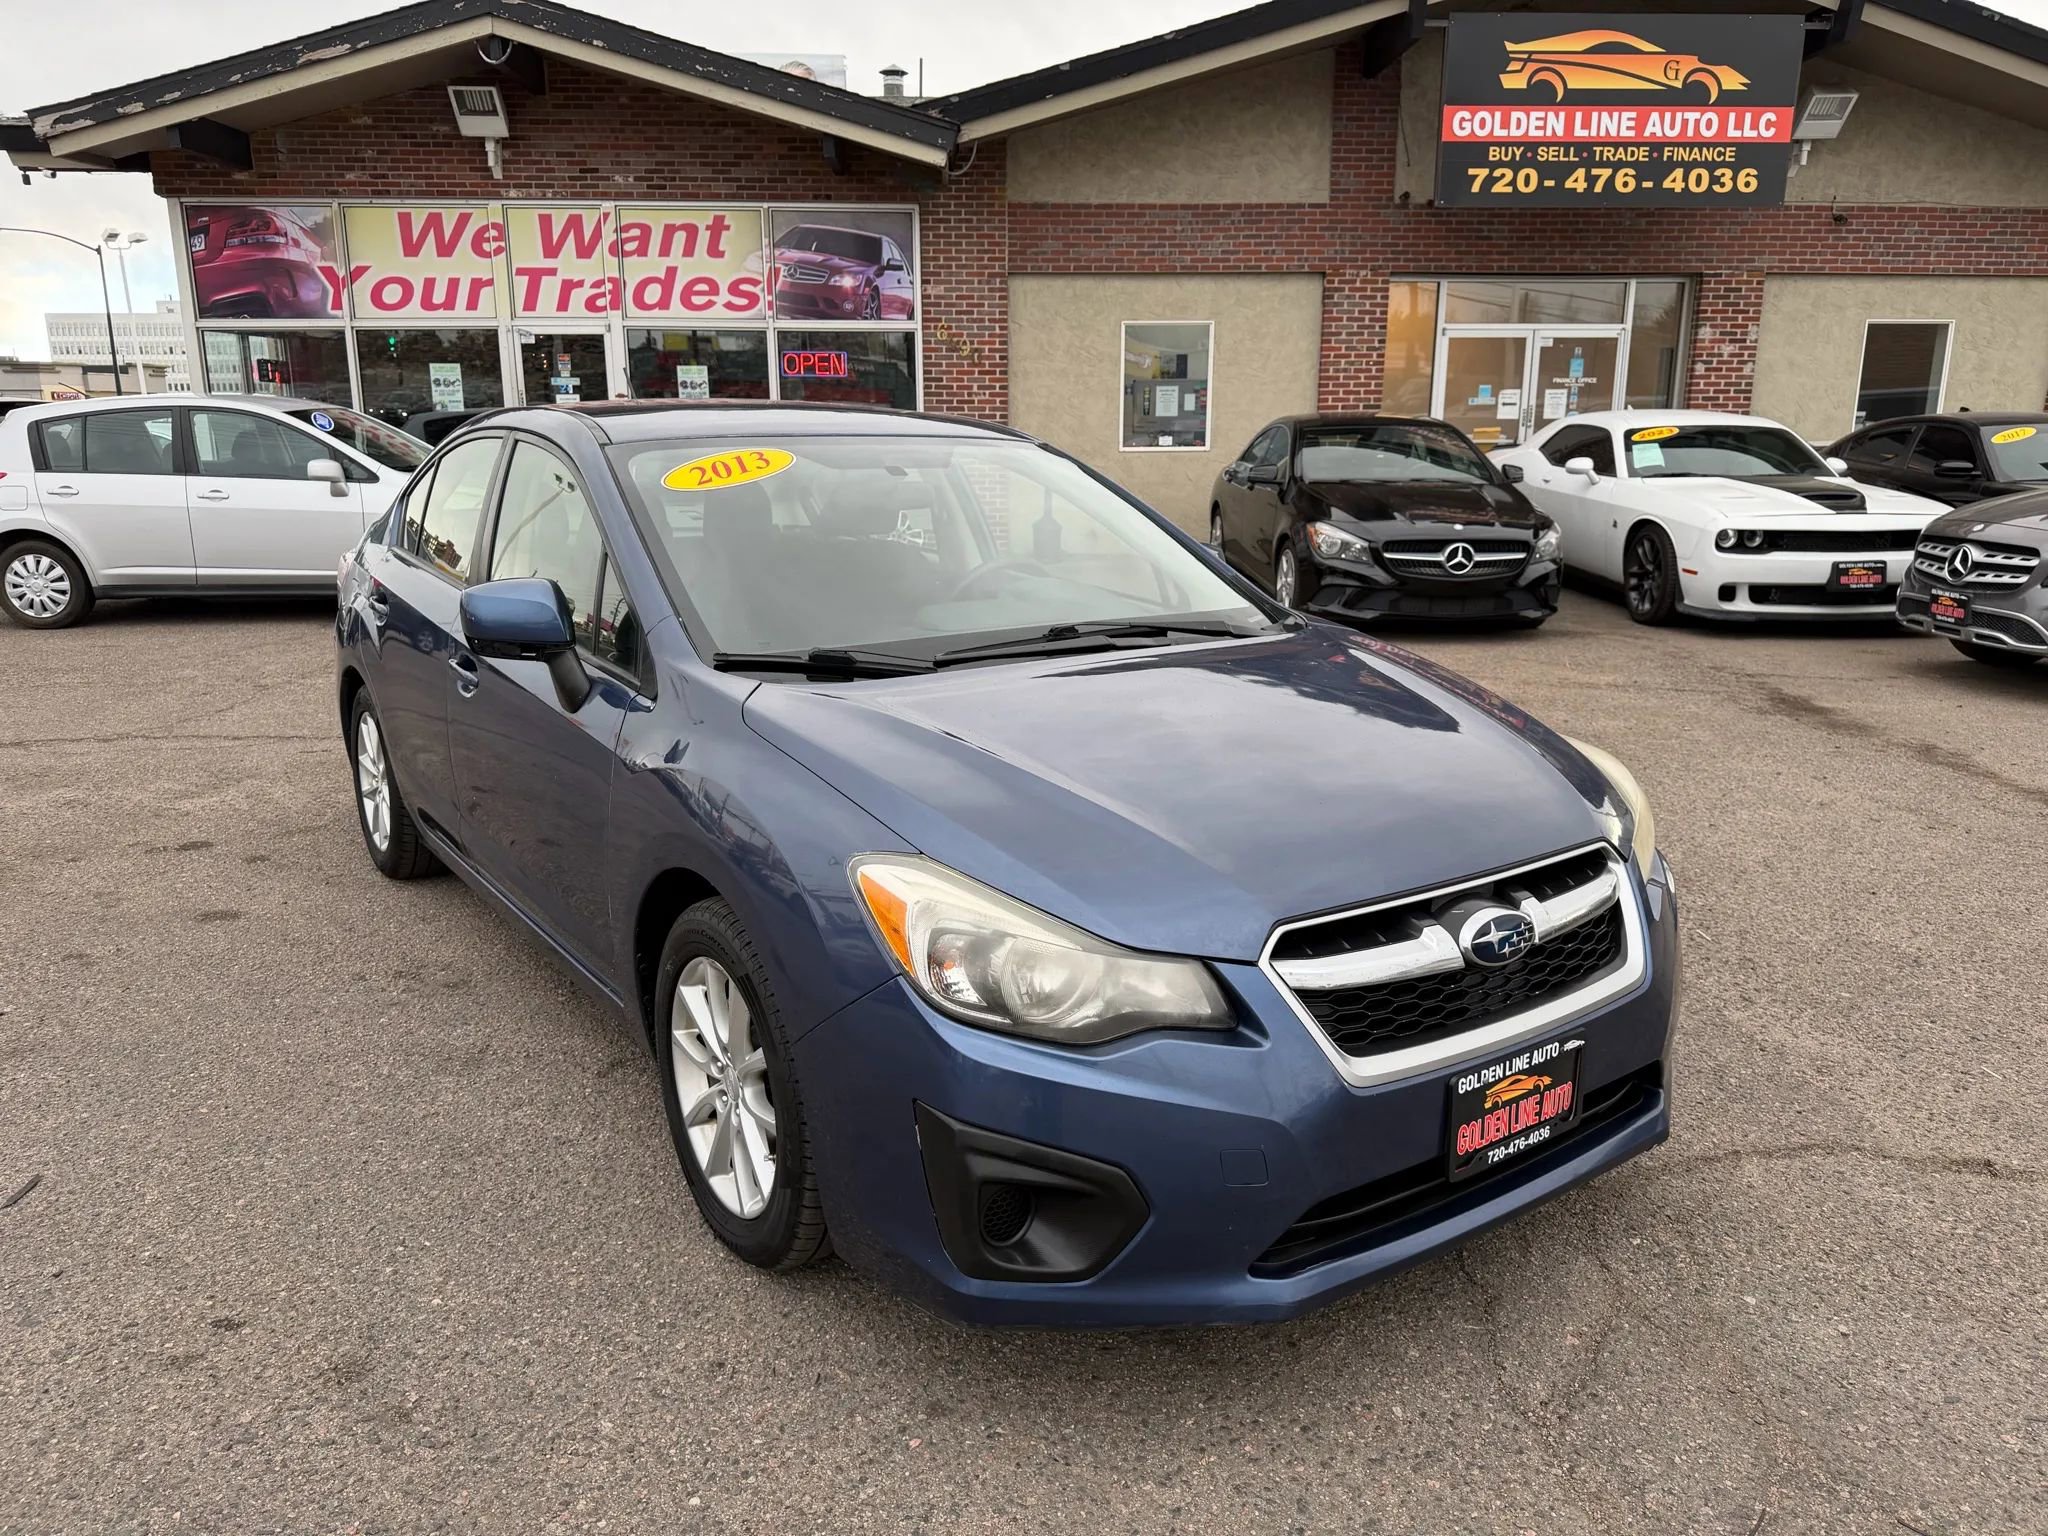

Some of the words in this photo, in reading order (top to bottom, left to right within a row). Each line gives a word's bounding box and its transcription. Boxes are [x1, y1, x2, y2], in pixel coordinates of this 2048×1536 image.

[1452, 110, 1566, 137] GOLDEN
[1573, 111, 1637, 137] LINE
[1643, 111, 1720, 138] AUTO
[1726, 112, 1778, 138] LLC
[1488, 146, 1525, 161] BUY
[1536, 146, 1580, 162] SELL
[1592, 146, 1650, 162] TRADE
[1662, 147, 1737, 162] FINANCE
[396, 211, 506, 260] We
[537, 211, 732, 260] Want
[317, 265, 495, 312] Your
[514, 265, 781, 314] Trades!
[783, 352, 845, 376] OPEN
[689, 451, 771, 486] 2013
[1458, 1063, 1504, 1094] GOLDEN
[1505, 1053, 1531, 1076] LINE
[1531, 1042, 1560, 1066] AUTO
[1456, 1106, 1510, 1156] GOLDEN
[1510, 1094, 1541, 1134] LINE
[1540, 1081, 1573, 1122] AUTO
[1487, 1125, 1551, 1164] 720-476-4036
